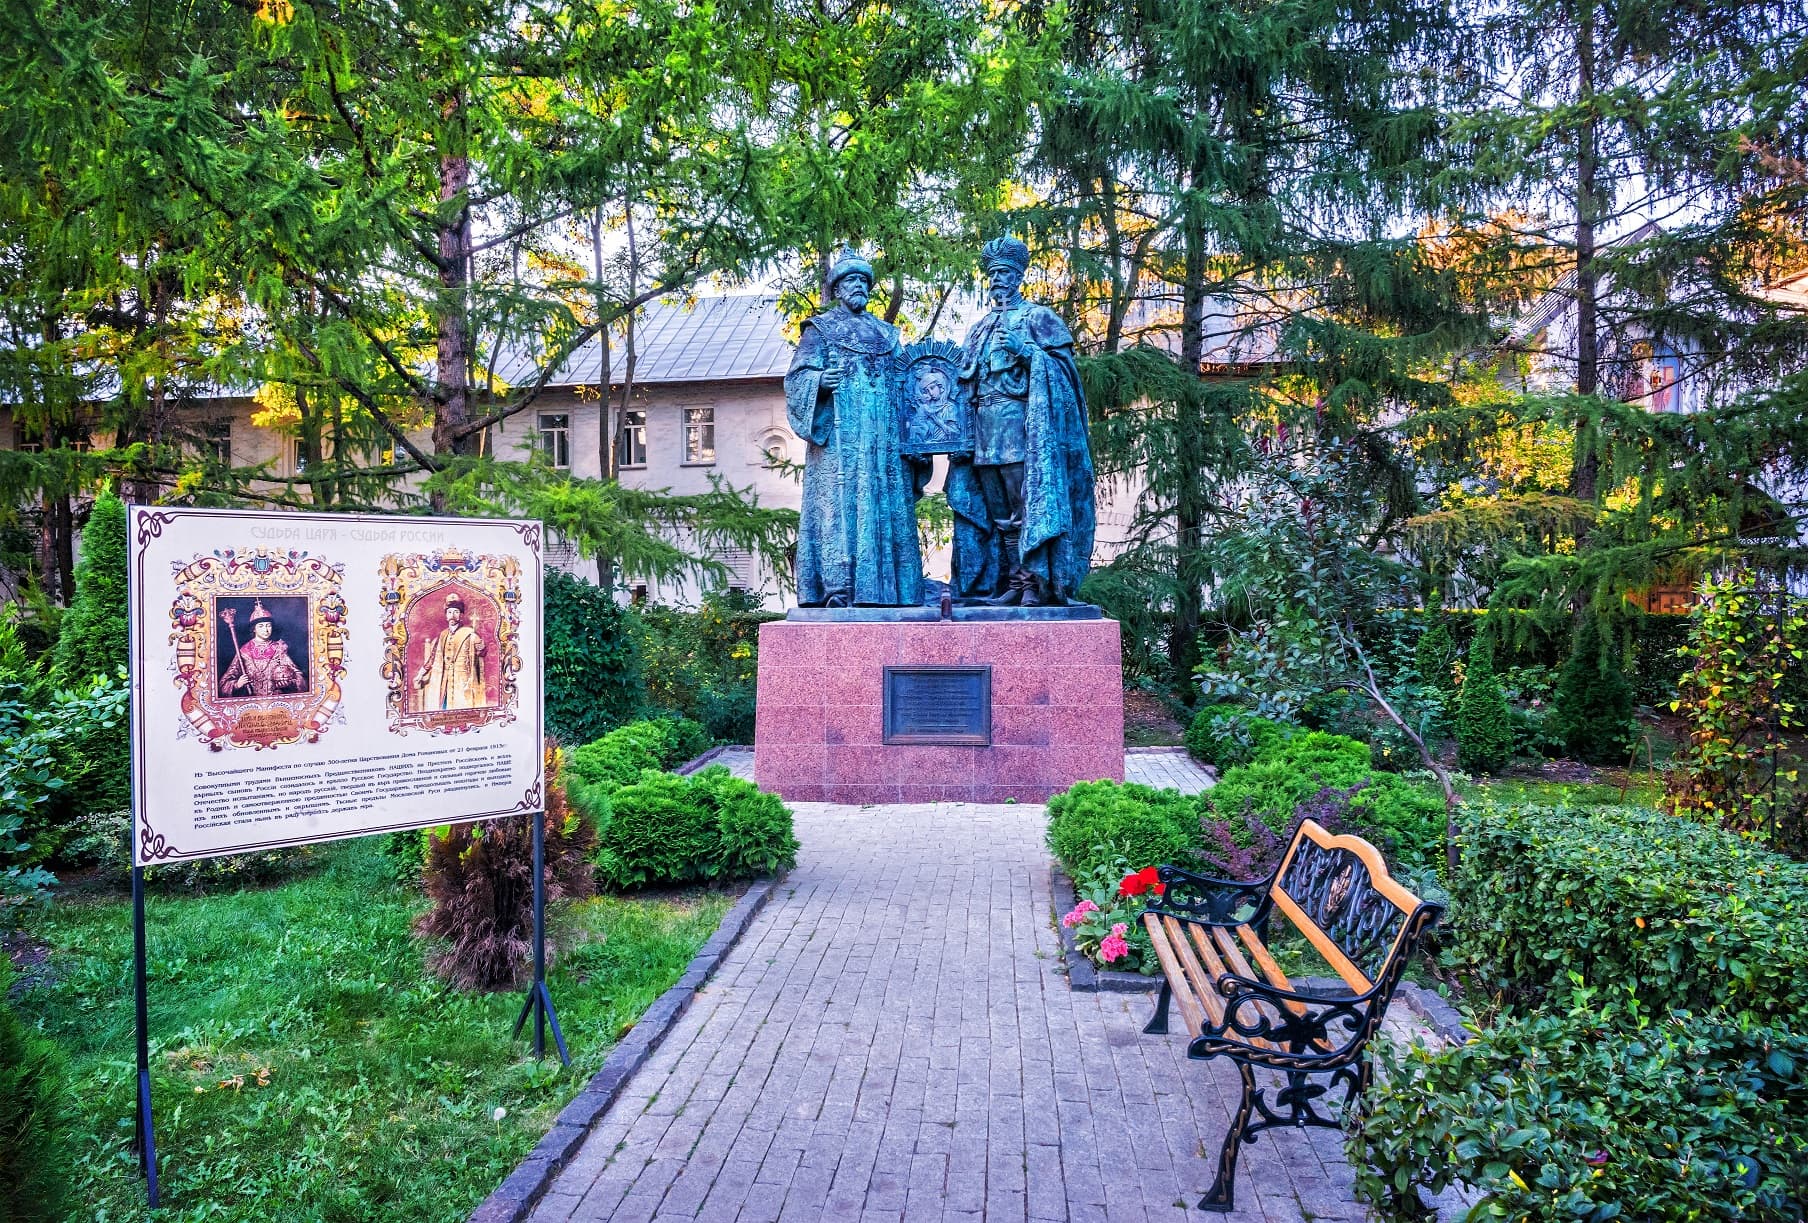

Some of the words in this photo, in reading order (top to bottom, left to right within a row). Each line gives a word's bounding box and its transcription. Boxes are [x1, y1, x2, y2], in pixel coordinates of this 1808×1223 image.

[251, 526, 300, 540] СУДЬБА
[305, 528, 338, 541] ЦАРЯ
[350, 529, 395, 542] СУДЬБА
